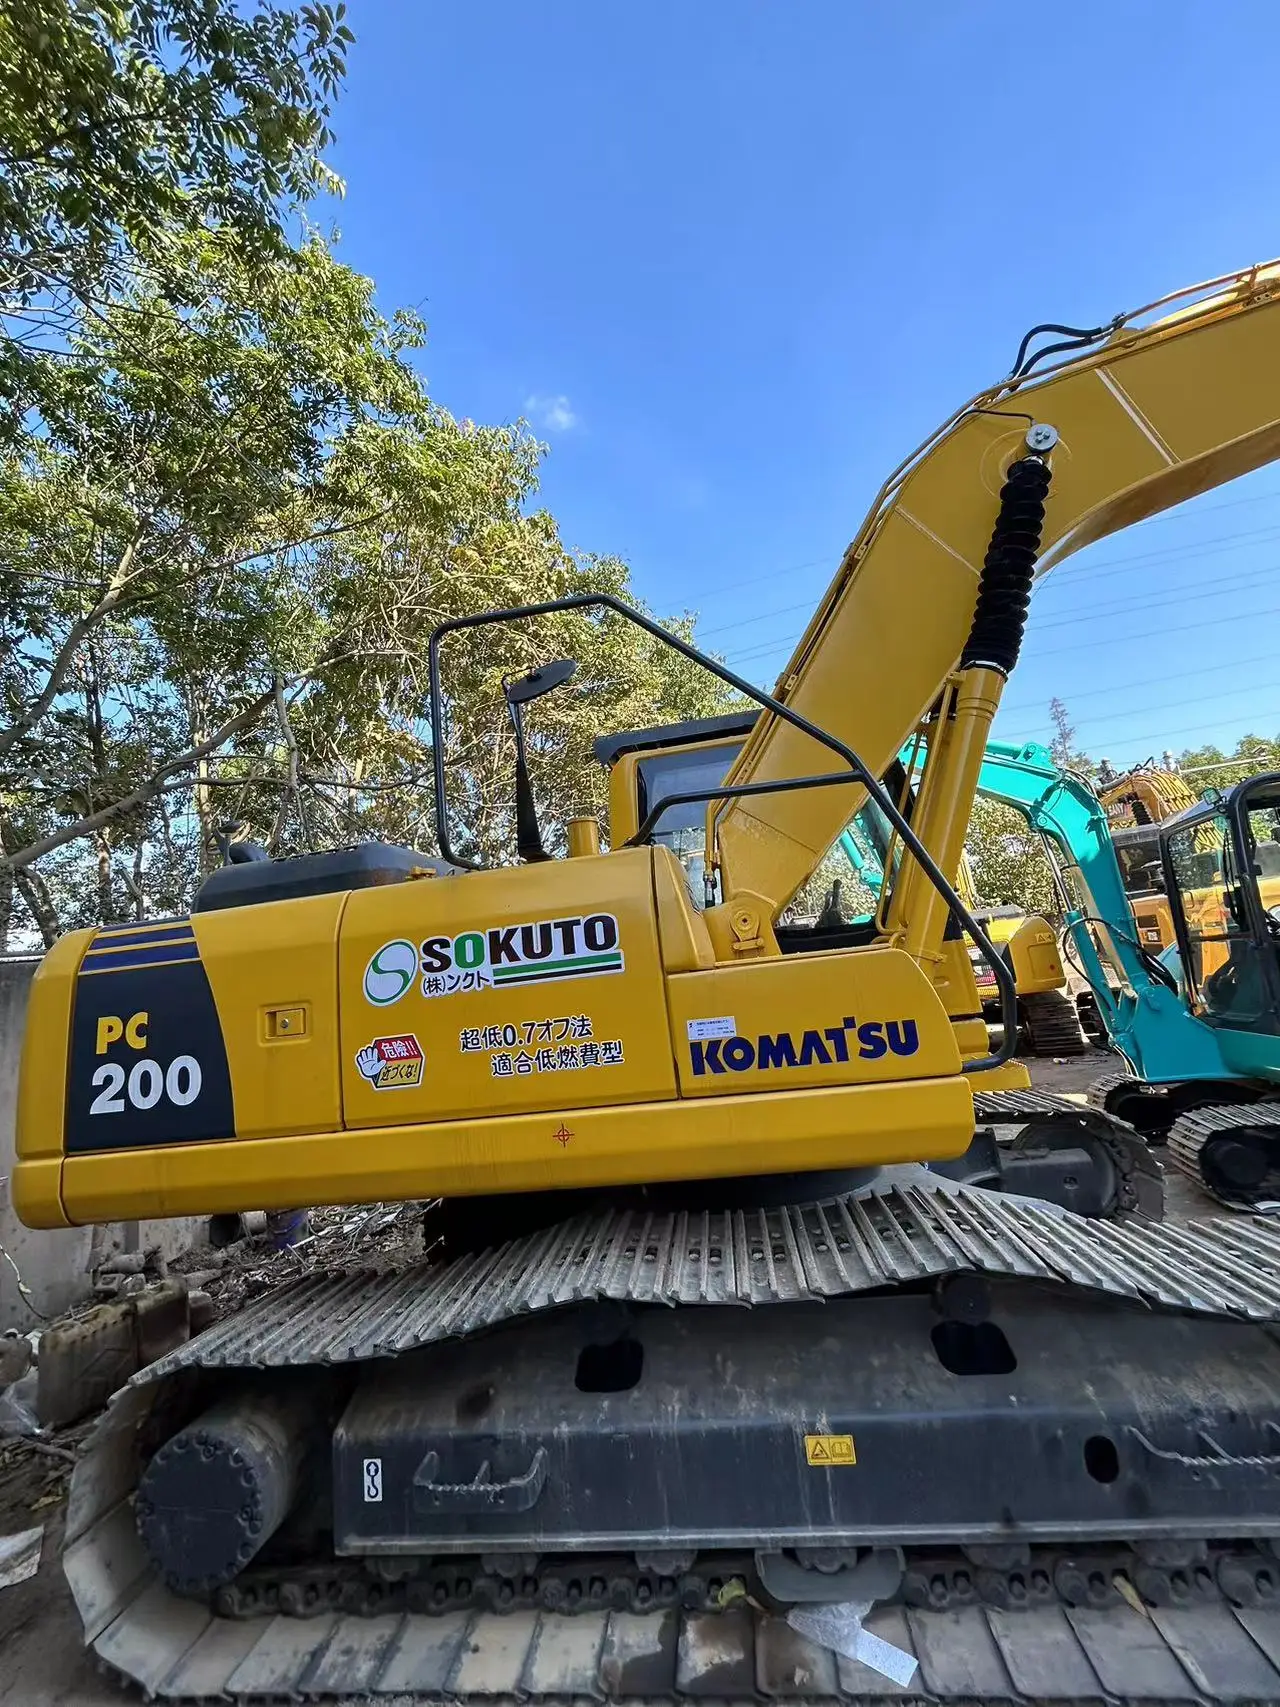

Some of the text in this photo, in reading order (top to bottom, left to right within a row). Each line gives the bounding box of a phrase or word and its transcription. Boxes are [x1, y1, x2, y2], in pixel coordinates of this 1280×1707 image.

[422, 915, 617, 973] SOKUTO
[96, 1011, 148, 1055] PC
[460, 1015, 592, 1051] 超低0.7オフ法
[690, 1016, 919, 1076] KOMATSU
[381, 1062, 418, 1081] 近づくな!
[492, 1040, 625, 1076] 適合低燃費型
[89, 1055, 202, 1115] 200
